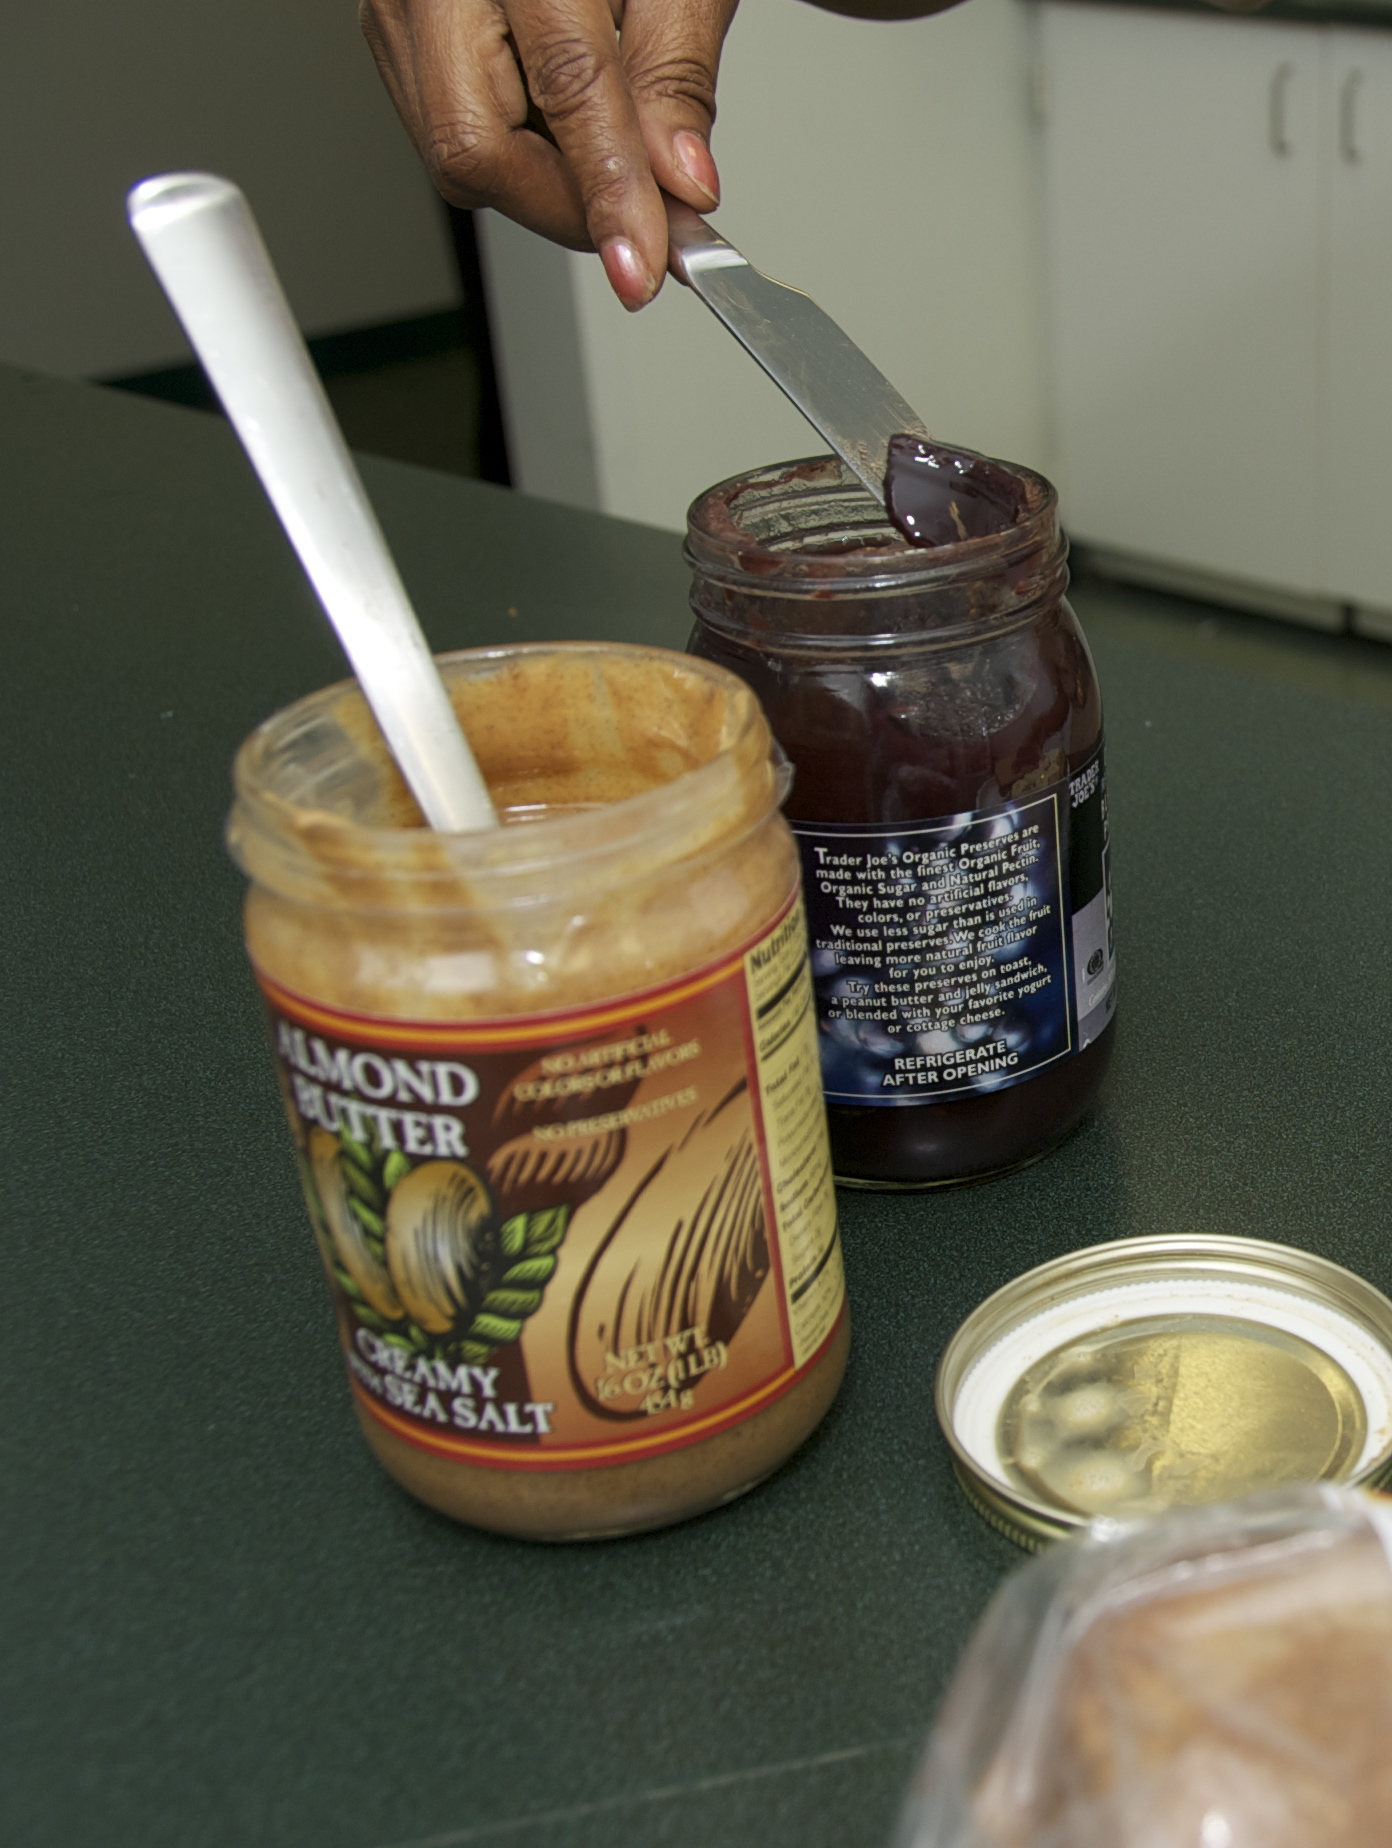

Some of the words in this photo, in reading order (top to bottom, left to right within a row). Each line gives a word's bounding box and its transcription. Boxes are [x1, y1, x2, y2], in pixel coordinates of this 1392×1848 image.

[814, 847, 862, 866] Trader
[866, 853, 898, 868] Joe's
[902, 847, 956, 865] Organic
[960, 831, 1019, 855] Preserves
[1022, 824, 1039, 838] are
[816, 868, 852, 880] made
[855, 868, 886, 880] with
[890, 867, 913, 879] the
[917, 862, 954, 877] finest
[959, 849, 1007, 869] Organic
[820, 881, 873, 896] Organic
[877, 882, 917, 896] Sugar
[921, 877, 945, 891] and
[950, 865, 998, 886] Natural
[1002, 854, 1039, 874] Pectin.
[830, 924, 853, 937] We
[856, 927, 879, 937] use
[883, 925, 908, 937] less
[912, 922, 949, 935] sugar
[953, 915, 982, 929] than
[985, 910, 995, 922] is
[998, 902, 1024, 918] used
[1027, 896, 1037, 908] in
[835, 896, 868, 912] They
[873, 897, 904, 908] have
[908, 896, 925, 907] no
[930, 883, 984, 904] artificial
[858, 911, 903, 923] colors,
[906, 911, 921, 921] or
[926, 893, 1013, 921] preservatives.
[816, 939, 883, 951] traditional
[886, 936, 952, 953] preserves.
[953, 929, 975, 942] We
[978, 920, 1006, 938] cook
[1009, 915, 1026, 929] the
[1029, 905, 1051, 921] fruit
[834, 952, 882, 968] leaving
[886, 954, 921, 965] more
[926, 942, 973, 961] natural
[977, 936, 1004, 953] fruit
[1006, 925, 1038, 944] flavor
[831, 996, 838, 1005] a
[842, 996, 887, 1008] peanut
[890, 994, 934, 1006] butter
[938, 988, 961, 1001] and
[965, 982, 991, 999] jelly
[995, 963, 1048, 989] sandwich,
[848, 981, 870, 995] Try
[874, 981, 910, 993] these
[914, 973, 977, 993] preserves
[981, 968, 997, 979] on
[1000, 956, 1032, 974] toast,
[889, 967, 908, 979] for
[912, 966, 936, 980] you
[941, 962, 955, 974] to
[958, 955, 995, 970] enjoy.
[828, 1009, 841, 1018] or
[845, 1009, 897, 1020] blended
[901, 1006, 931, 1019] with
[935, 1003, 964, 1019] your
[968, 990, 1015, 1010] favorite
[1018, 974, 1052, 998] yogurt
[887, 1024, 901, 1034] or
[906, 1019, 956, 1031] cottage
[960, 1009, 1006, 1025] cheese.
[278, 1021, 480, 1107] ALMOND
[882, 1070, 940, 1087] AFTER
[942, 1052, 1019, 1080] OPENING
[894, 1040, 1007, 1070] REFRIGERATE
[293, 1074, 469, 1158] BUTTER
[356, 1327, 500, 1398] CREAMY
[604, 1341, 662, 1374] NET
[384, 1373, 448, 1423] SEA
[451, 1396, 555, 1434] SALT
[597, 1374, 622, 1400] 16
